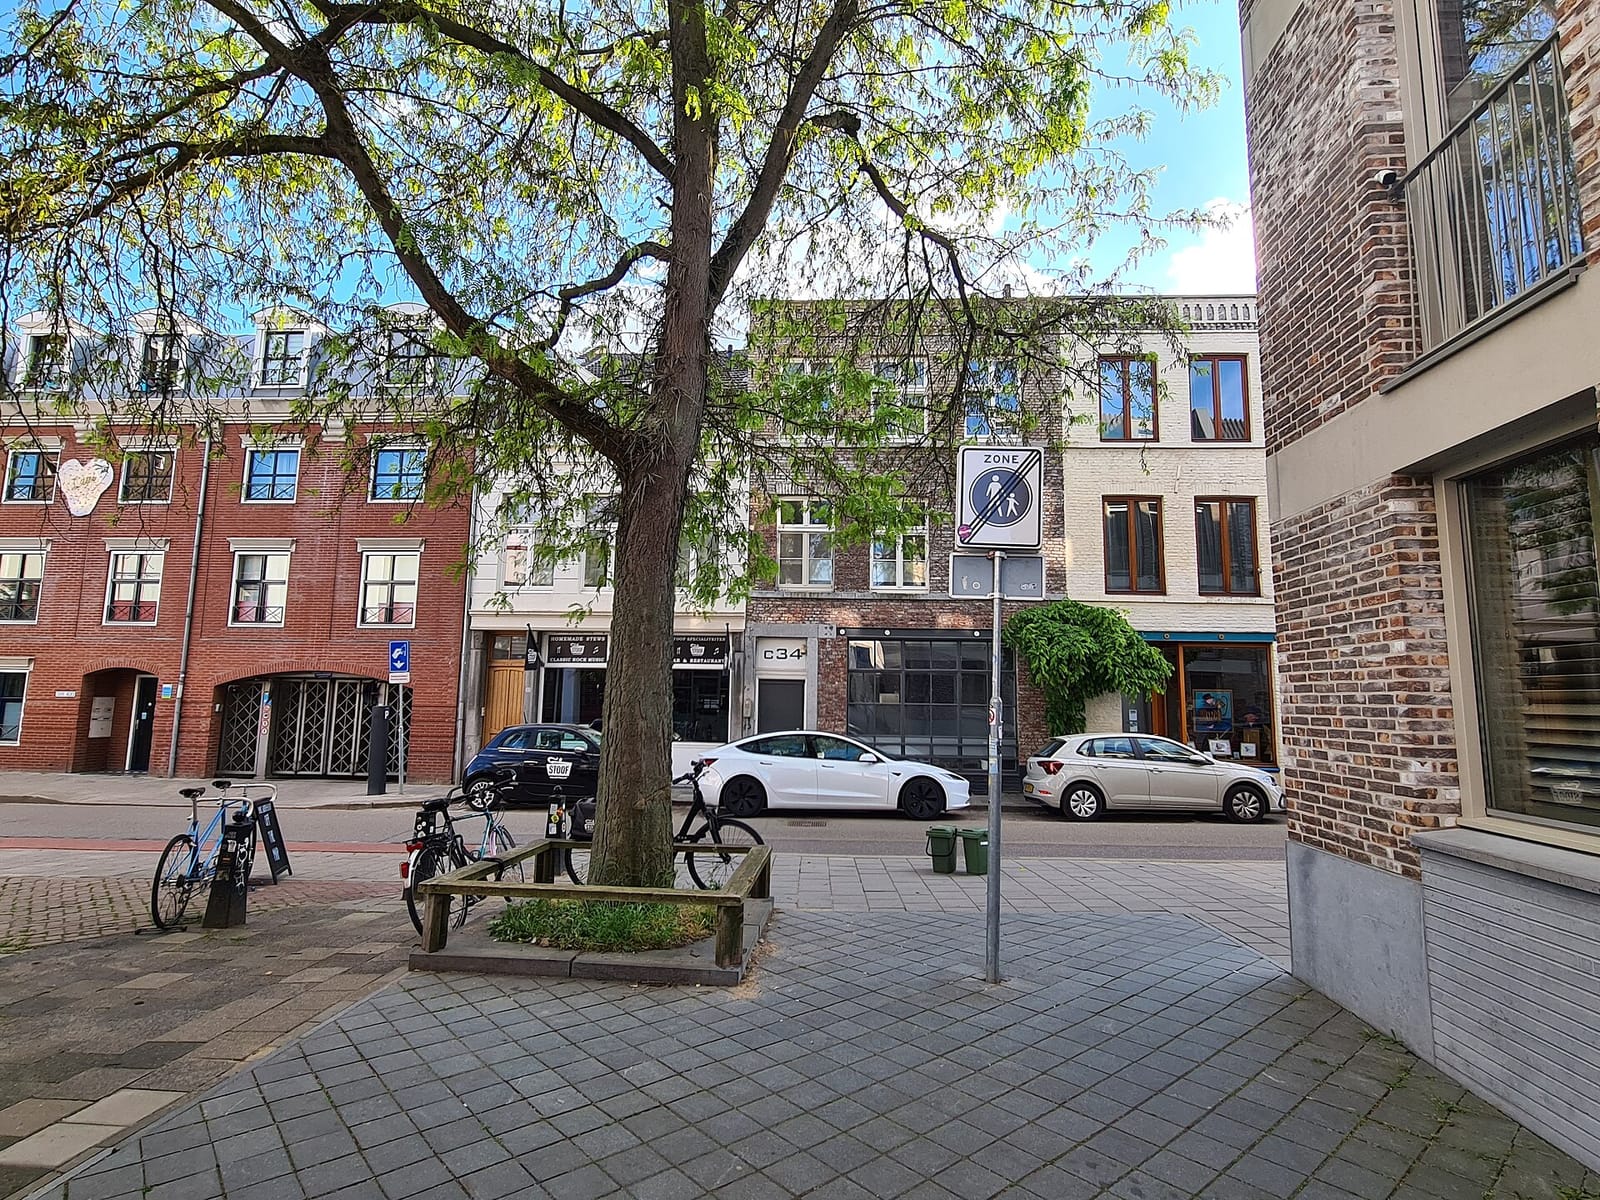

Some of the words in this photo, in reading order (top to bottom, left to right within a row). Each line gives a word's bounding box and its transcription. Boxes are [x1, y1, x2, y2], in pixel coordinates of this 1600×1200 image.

[984, 455, 1019, 463] ZONE
[384, 710, 390, 719] P
[549, 765, 569, 774] STOOF
